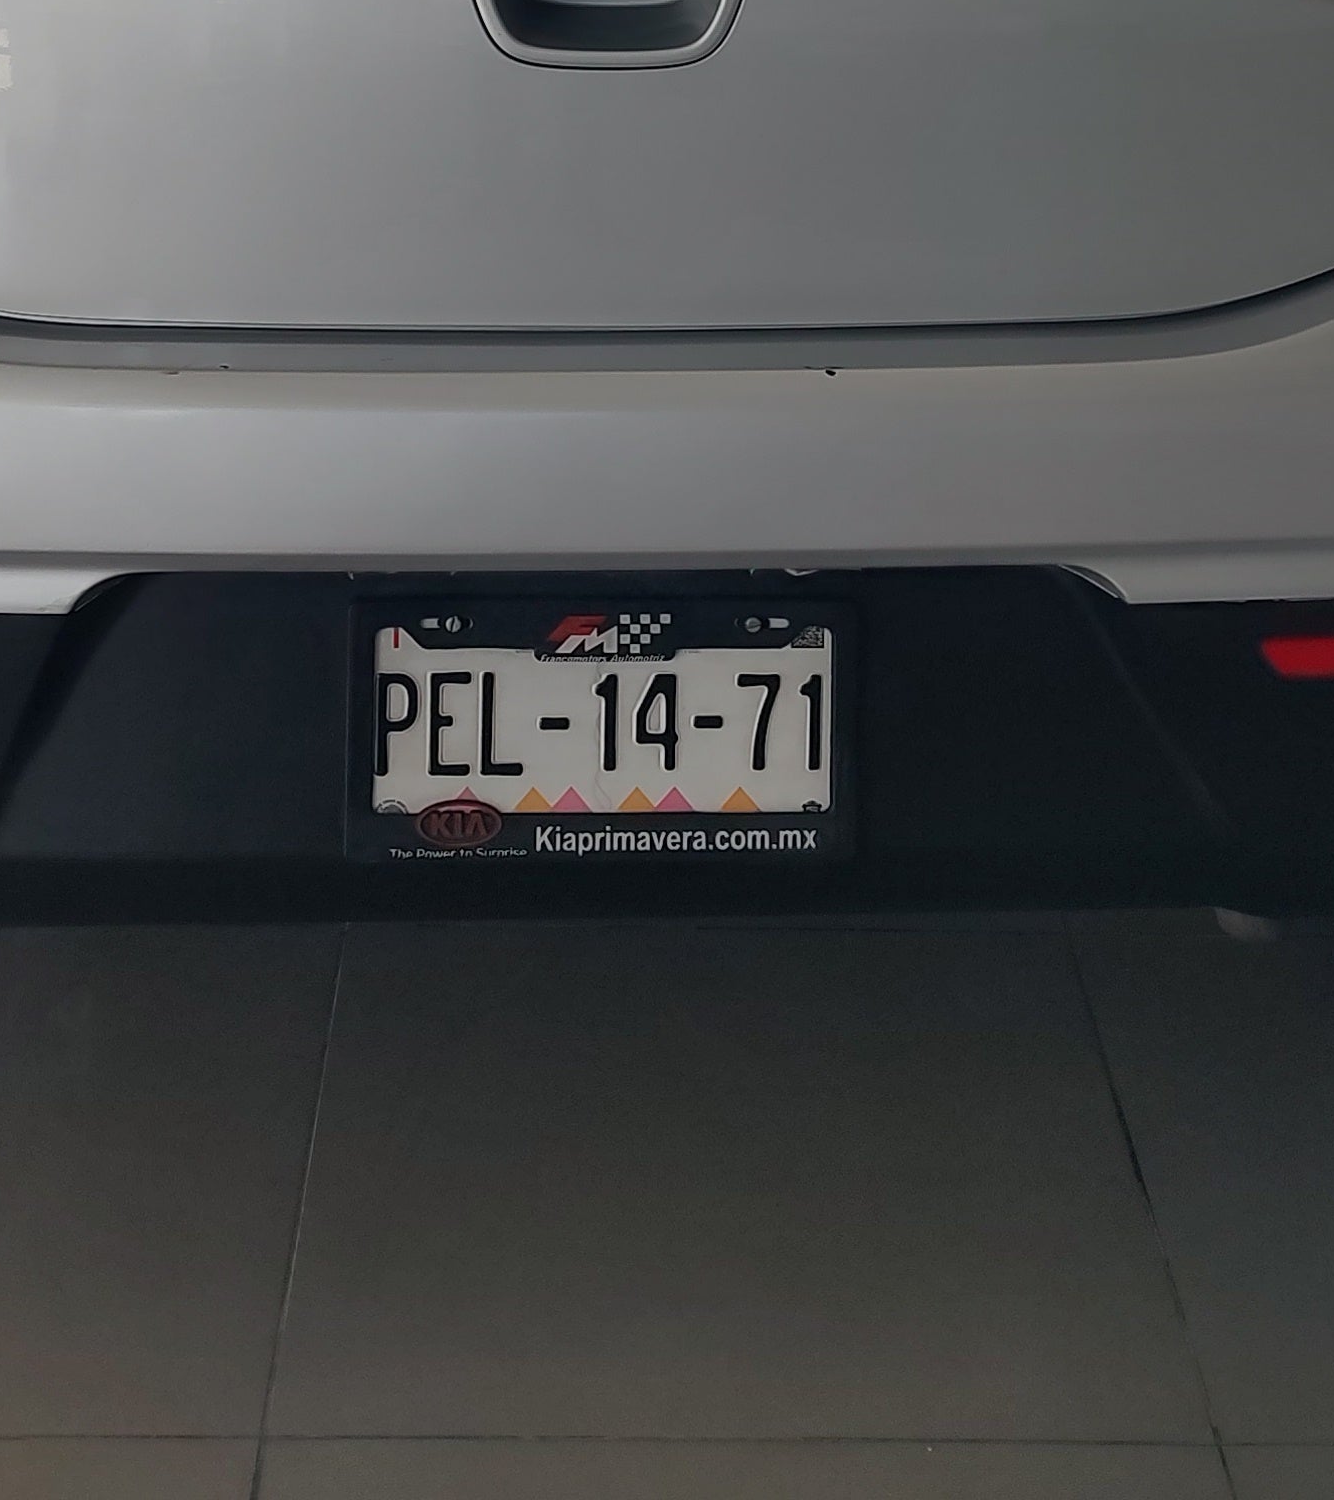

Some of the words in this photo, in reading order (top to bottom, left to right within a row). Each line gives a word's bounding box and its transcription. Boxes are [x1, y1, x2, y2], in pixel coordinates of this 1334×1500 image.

[377, 672, 822, 777] PEL-14-71
[430, 811, 488, 837] KIA
[536, 826, 817, 856] Kiaprimavera.com.mx
